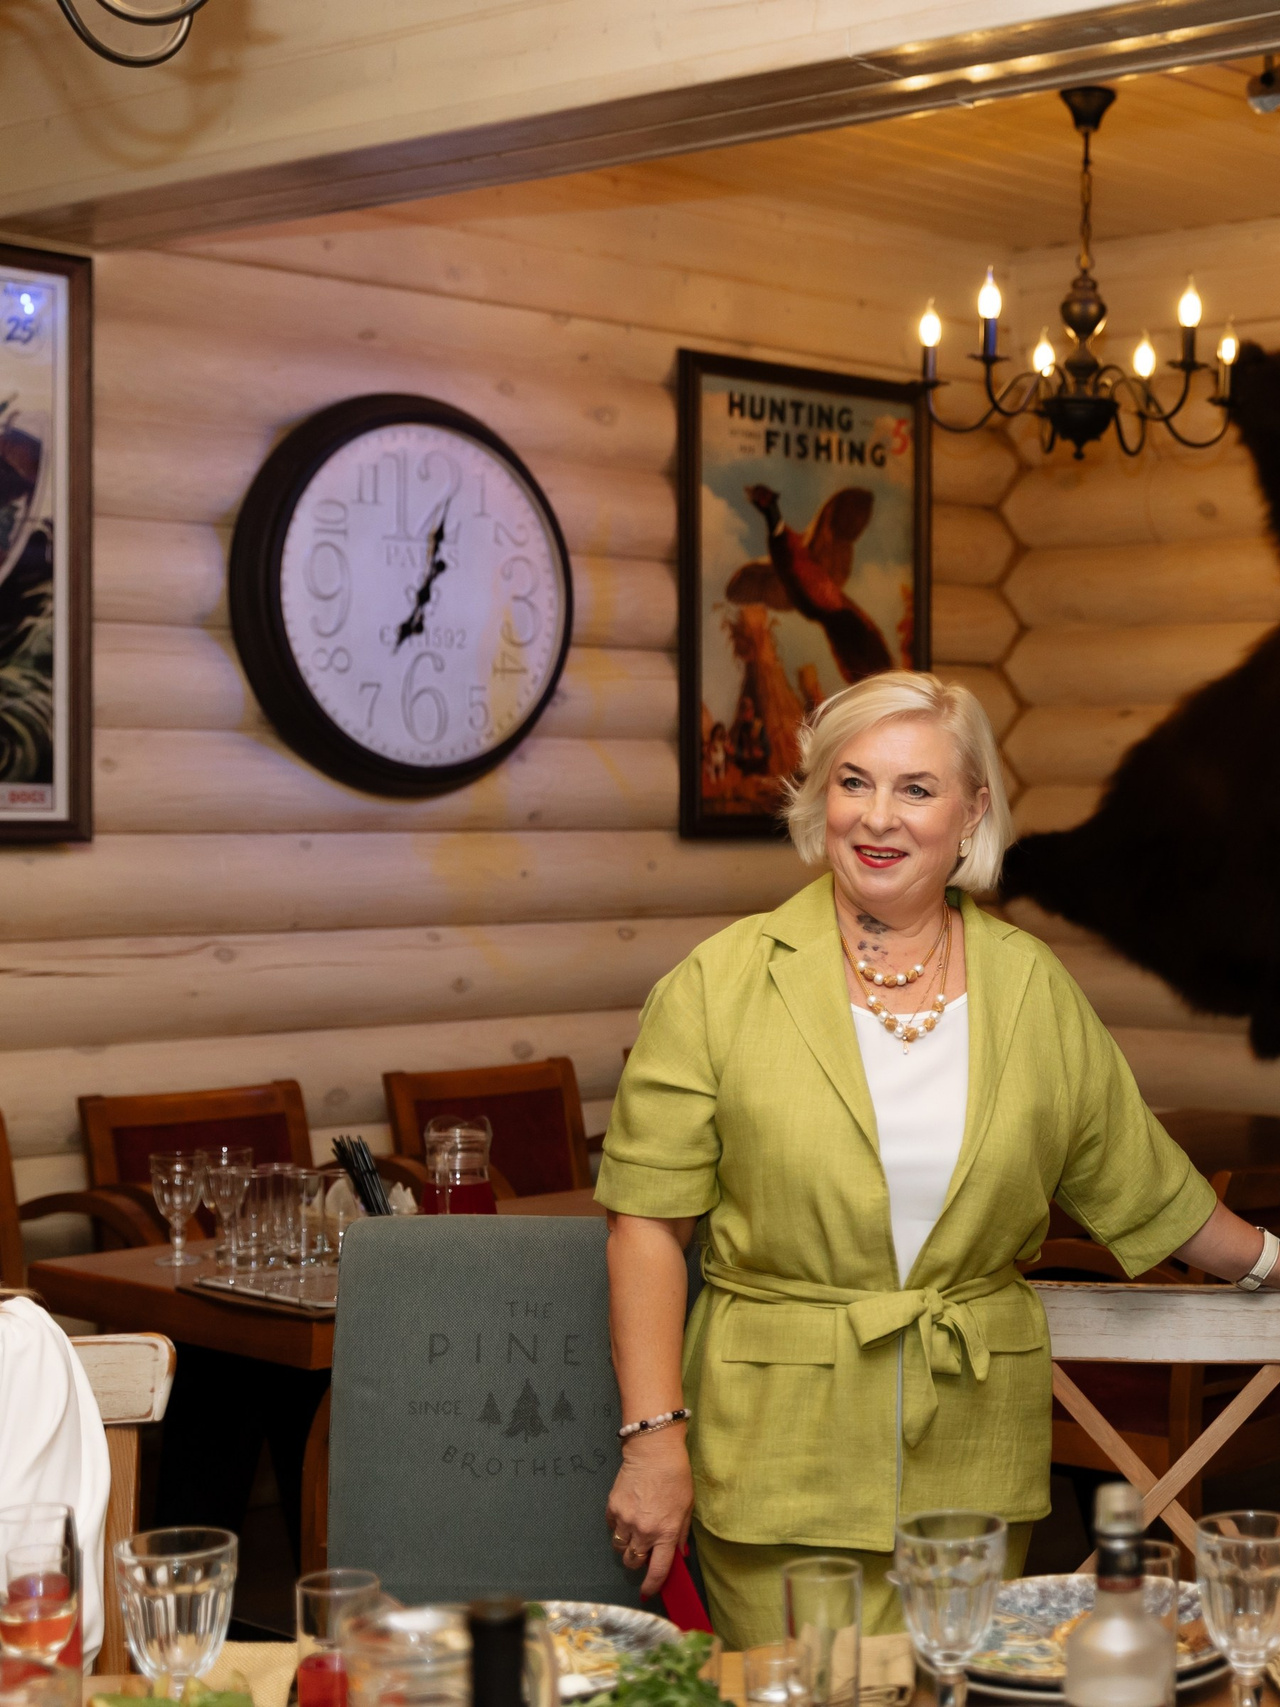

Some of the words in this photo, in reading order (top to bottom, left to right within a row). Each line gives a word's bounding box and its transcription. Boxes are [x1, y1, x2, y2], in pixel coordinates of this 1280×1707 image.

[728, 391, 852, 433] HUNTING
[765, 430, 886, 467] FISHING
[891, 417, 909, 455] 5
[353, 463, 381, 505] 11
[381, 449, 461, 546] 12
[473, 472, 490, 517] 1
[313, 499, 349, 540] 10
[493, 521, 529, 547] 2
[304, 541, 353, 639] 9
[500, 555, 541, 648] 3
[316, 646, 351, 674] 8
[491, 658, 529, 682] 4
[359, 683, 381, 728] 7
[401, 652, 450, 745] 6
[468, 687, 489, 732] 5
[506, 1301, 555, 1320] THE
[427, 1333, 614, 1366] PINE
[407, 1400, 463, 1416] SINCE
[441, 1446, 608, 1479] BROTHERS
